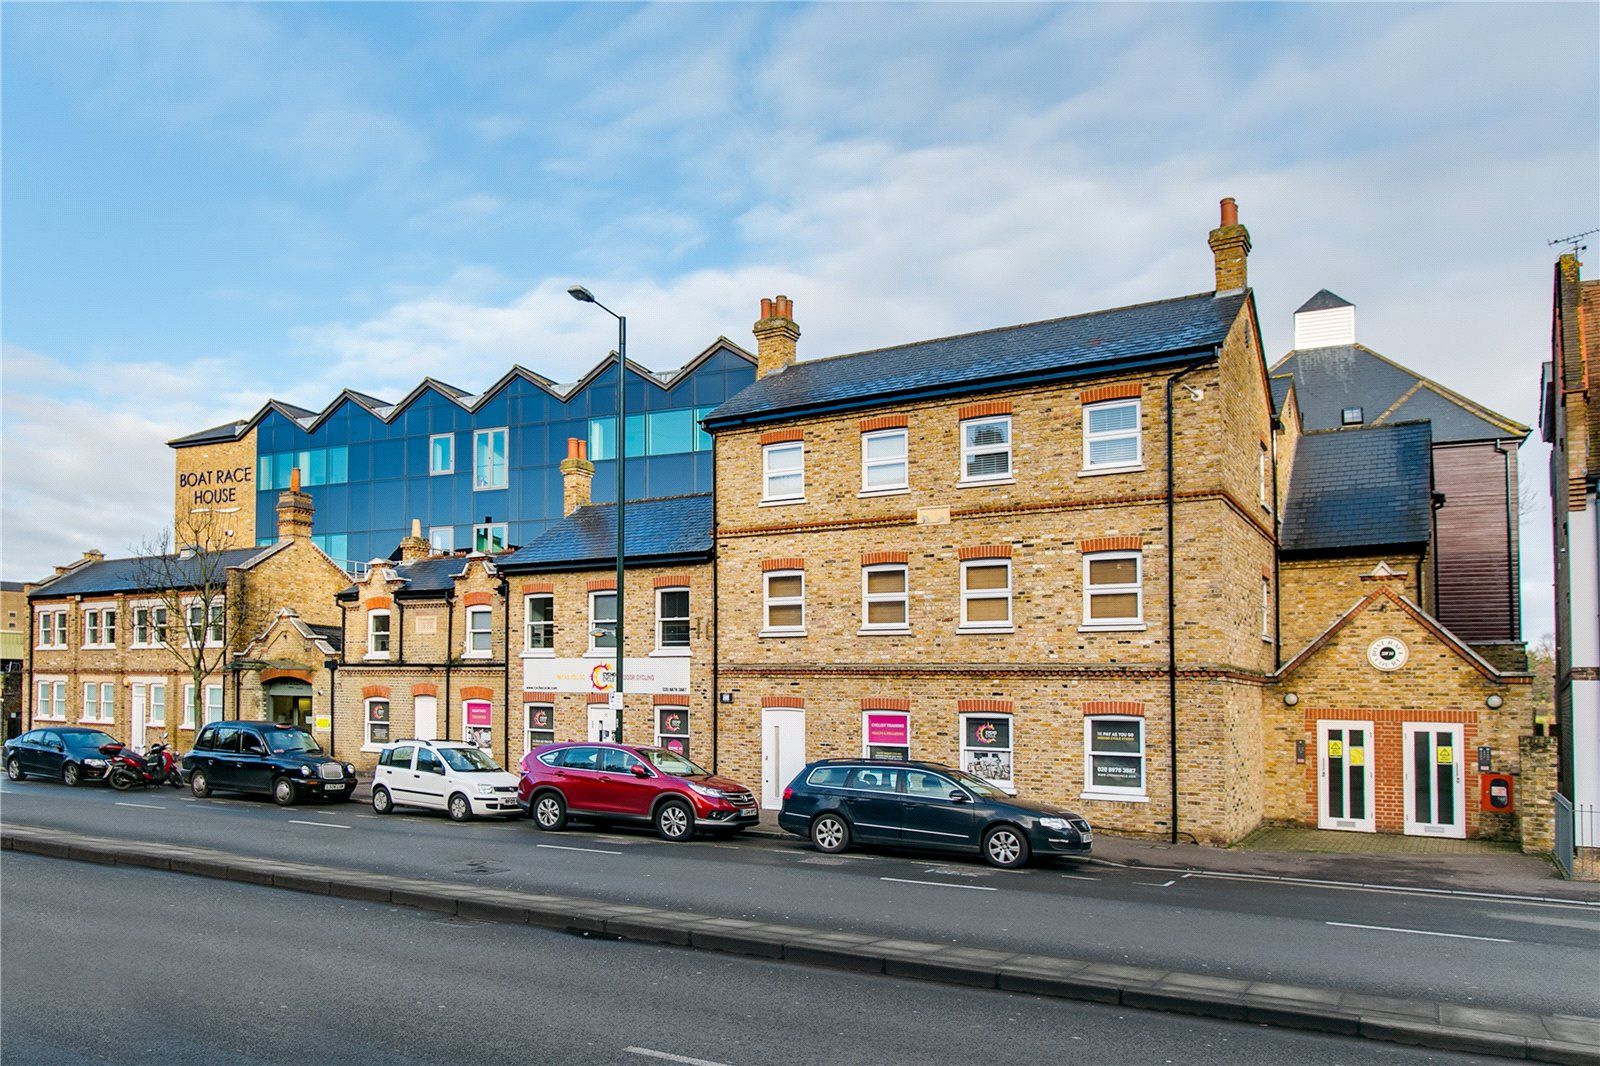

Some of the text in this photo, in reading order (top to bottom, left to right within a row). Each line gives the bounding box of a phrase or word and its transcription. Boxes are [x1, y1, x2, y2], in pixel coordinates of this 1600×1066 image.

[180, 466, 252, 487] BOAT RACE
[194, 488, 236, 505] HOUSE
